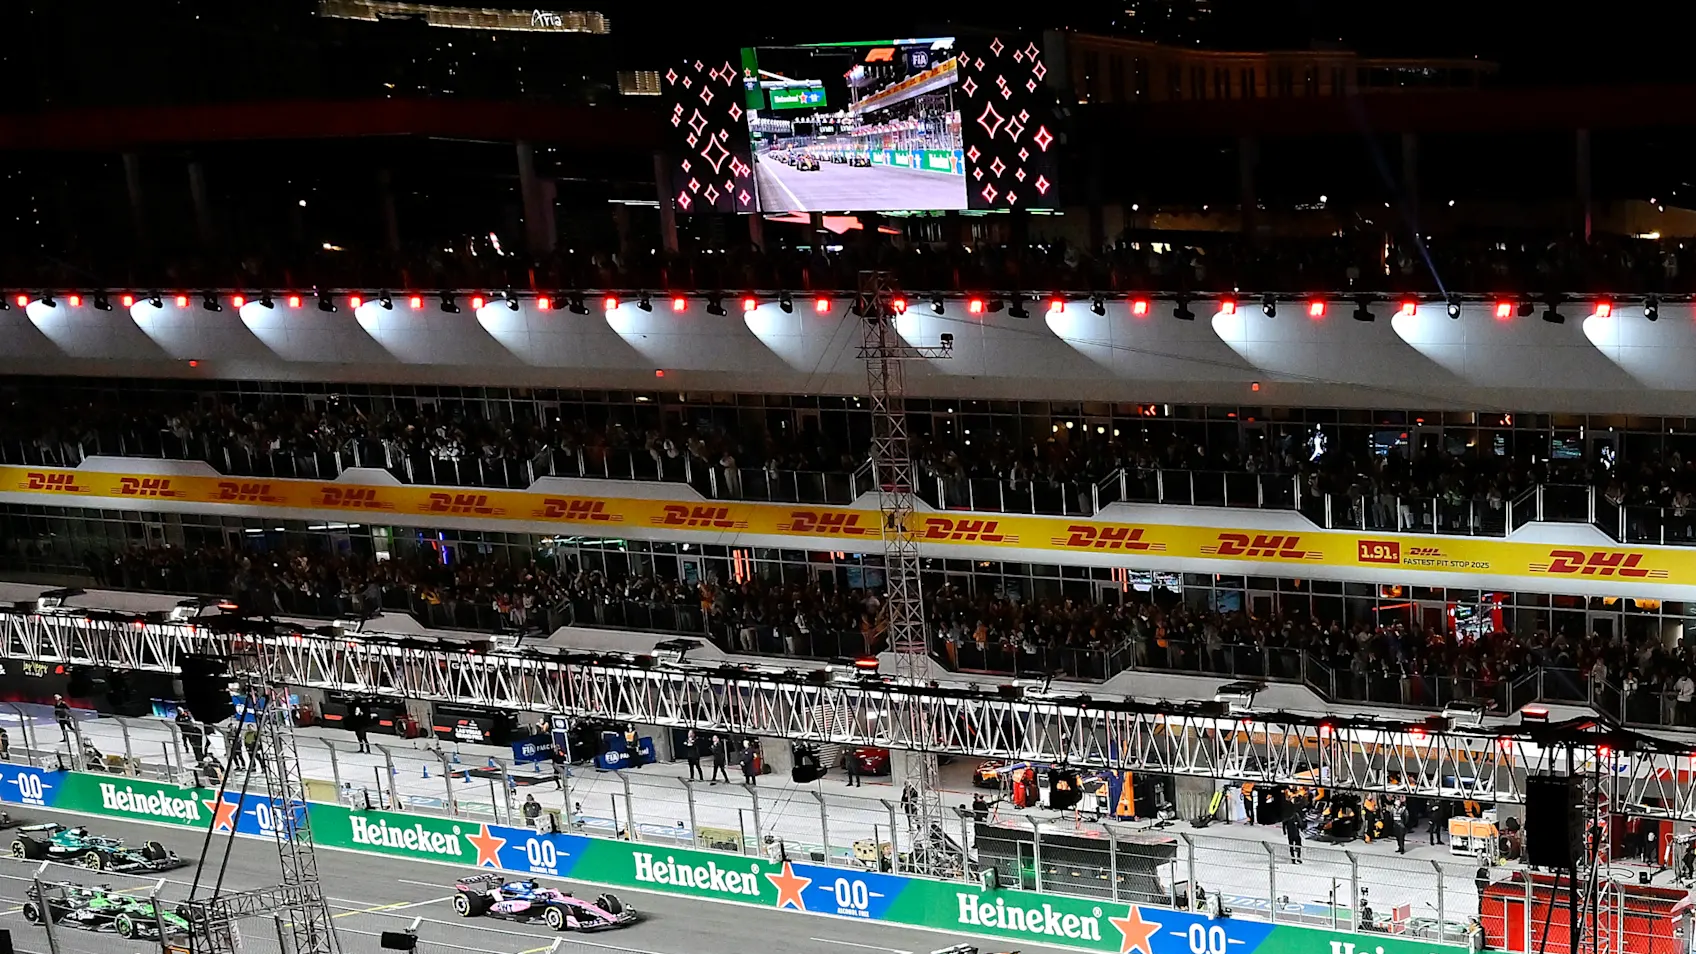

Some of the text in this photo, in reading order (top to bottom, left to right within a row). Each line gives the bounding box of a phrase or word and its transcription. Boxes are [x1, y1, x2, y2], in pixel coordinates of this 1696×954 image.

[531, 9, 562, 28] Aria
[27, 472, 80, 492] DHL
[120, 477, 176, 497] DHL
[218, 482, 276, 502] DHL
[320, 487, 381, 508] DHL
[429, 492, 493, 514] DHL
[543, 499, 611, 521] DHL
[663, 505, 735, 528] DHL
[790, 511, 868, 535] DHL
[924, 518, 1005, 542] DHL
[1066, 525, 1151, 550] DHL
[1216, 533, 1306, 558] DHL
[1403, 558, 1435, 566] FASTEST
[1409, 547, 1441, 556] DHL
[1547, 551, 1649, 577] DHL
[18, 772, 43, 800] 0.0
[526, 837, 558, 868] 0.0
[834, 877, 869, 910] 0.0
